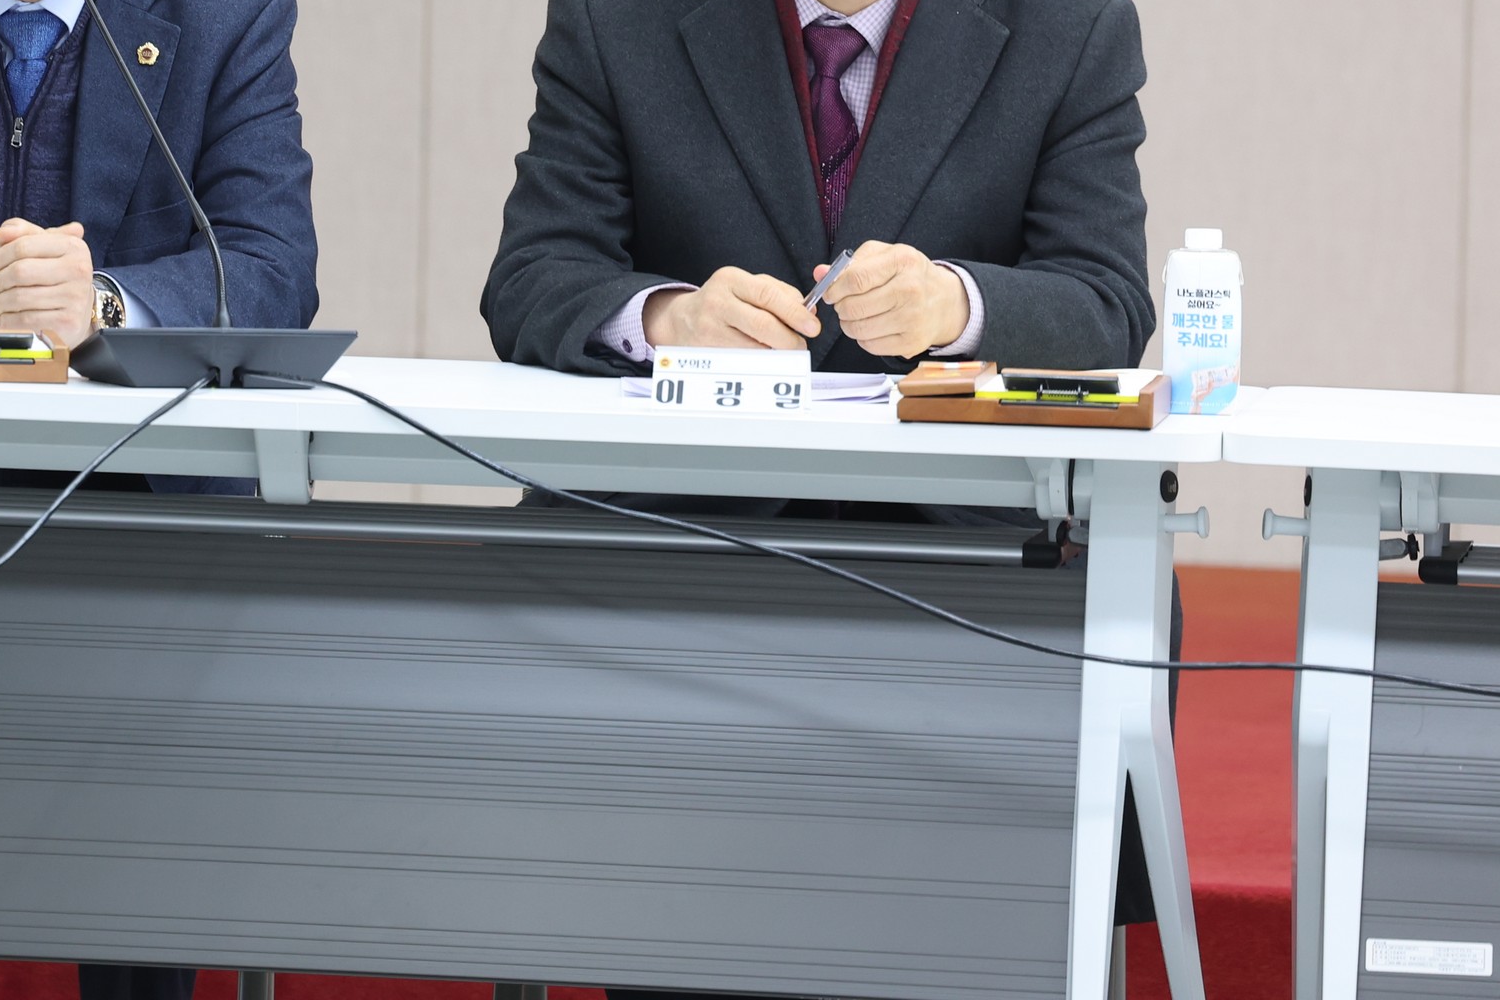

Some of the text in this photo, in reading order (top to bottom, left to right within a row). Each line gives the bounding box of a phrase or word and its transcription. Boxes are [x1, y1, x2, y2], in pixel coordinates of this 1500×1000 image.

[1177, 288, 1231, 299] 나노플라스틱
[1187, 299, 1221, 309] 싫어요~
[1172, 313, 1234, 330] 깨끗한 물
[1177, 332, 1228, 348] 주세요!
[678, 359, 712, 369] 부의장
